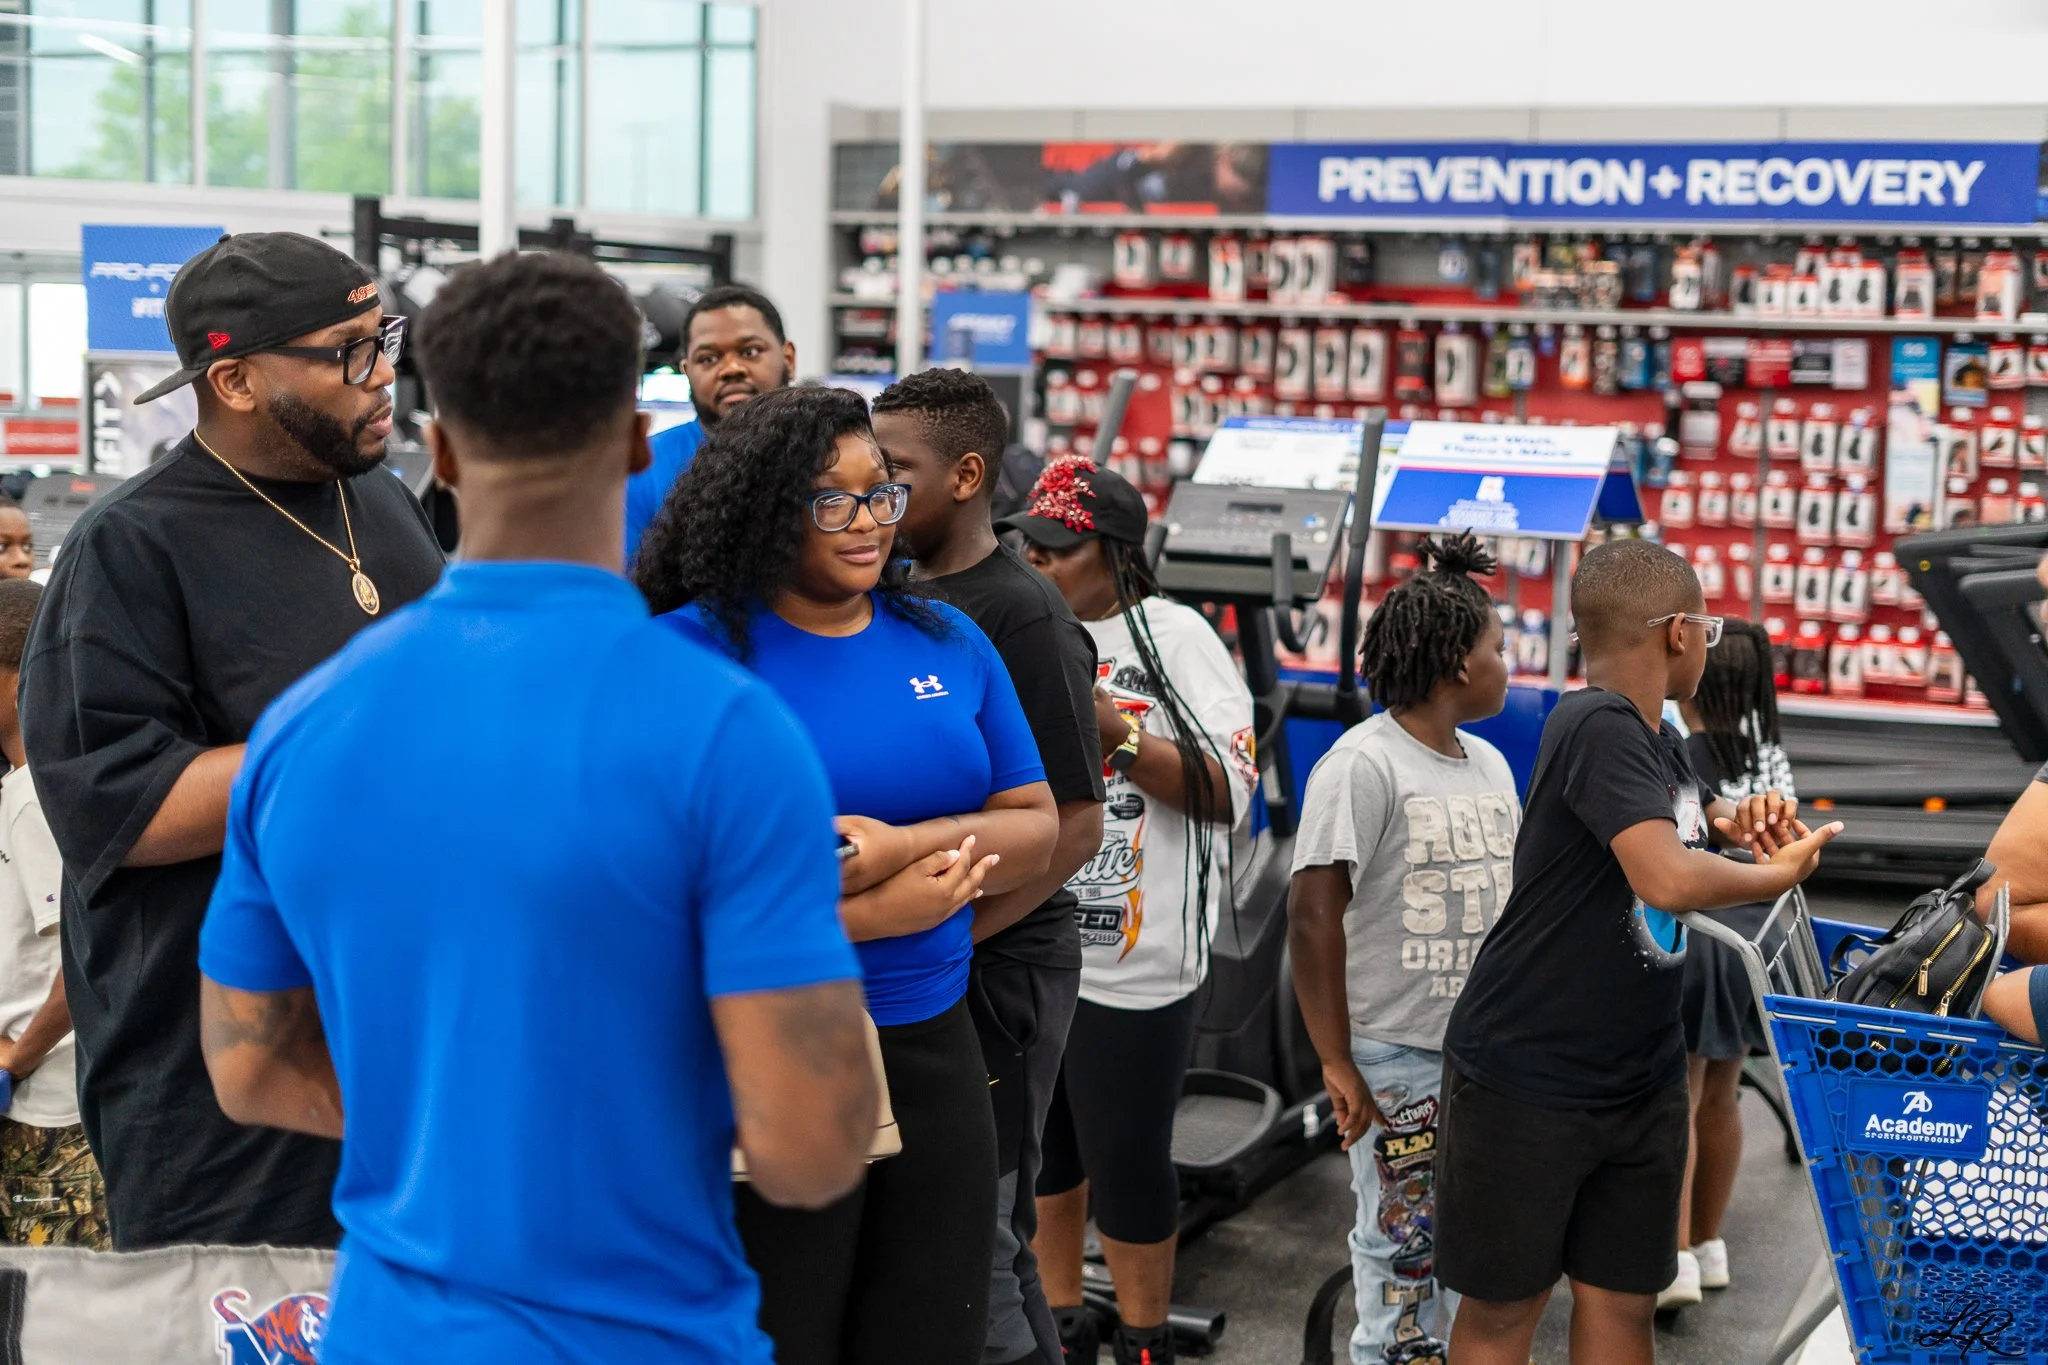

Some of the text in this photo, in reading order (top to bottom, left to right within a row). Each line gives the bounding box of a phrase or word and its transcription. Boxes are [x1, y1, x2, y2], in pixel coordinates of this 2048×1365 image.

[1319, 158, 1645, 204] PREVENTION
[1686, 159, 1985, 205] RECOVERY
[1865, 1113, 1972, 1142] Academy
